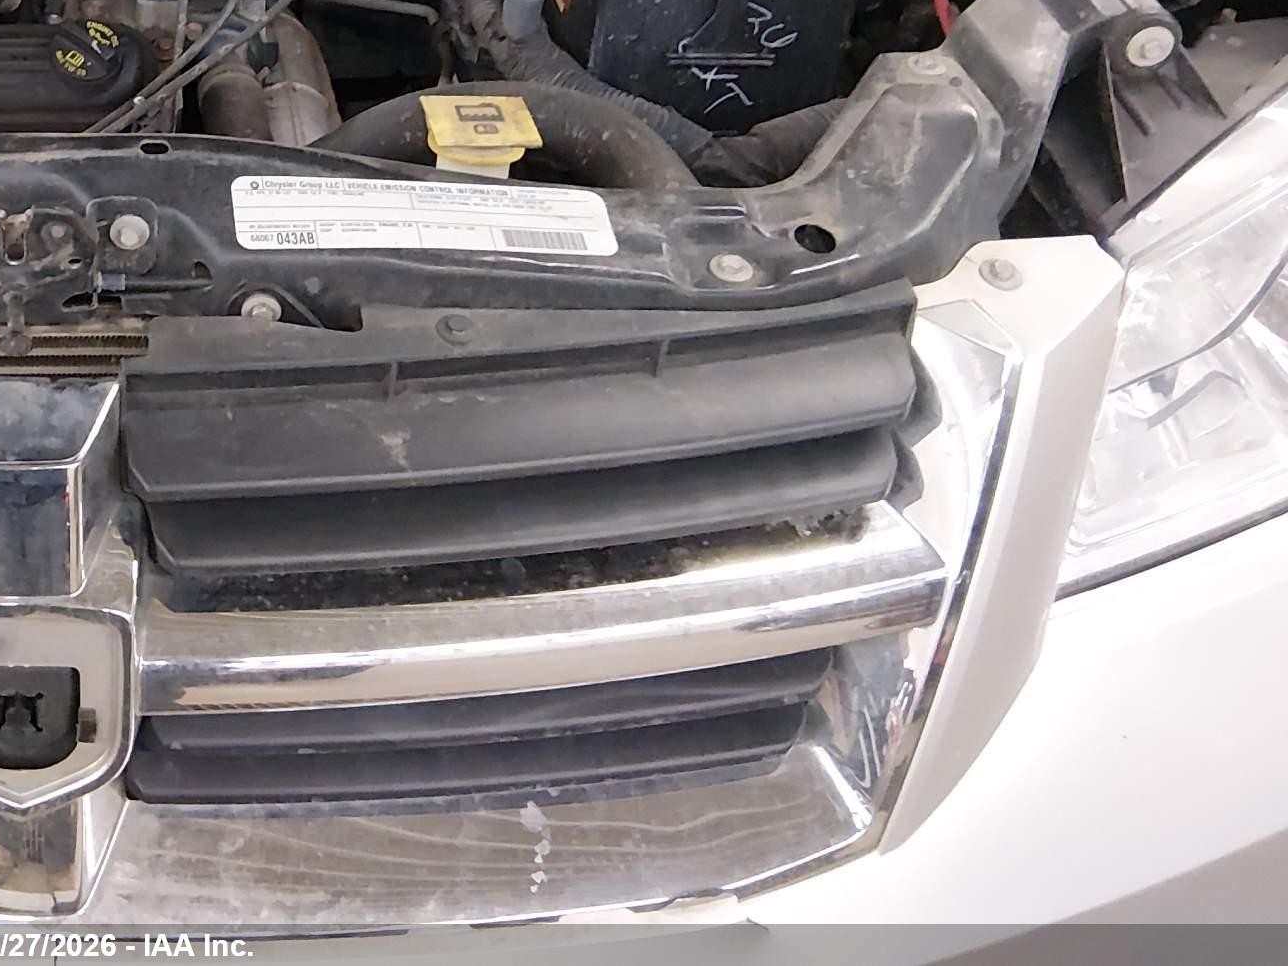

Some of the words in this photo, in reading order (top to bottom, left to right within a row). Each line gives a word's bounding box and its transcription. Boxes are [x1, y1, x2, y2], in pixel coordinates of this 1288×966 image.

[264, 180, 297, 191] Chrysler
[299, 180, 323, 191] Group
[325, 181, 341, 190] LLC
[347, 182, 378, 191] VEHICLE
[380, 184, 417, 192] EMISSION
[419, 185, 454, 195] CONTROL
[456, 187, 510, 197] INFORMATION
[276, 232, 315, 246] 043AB
